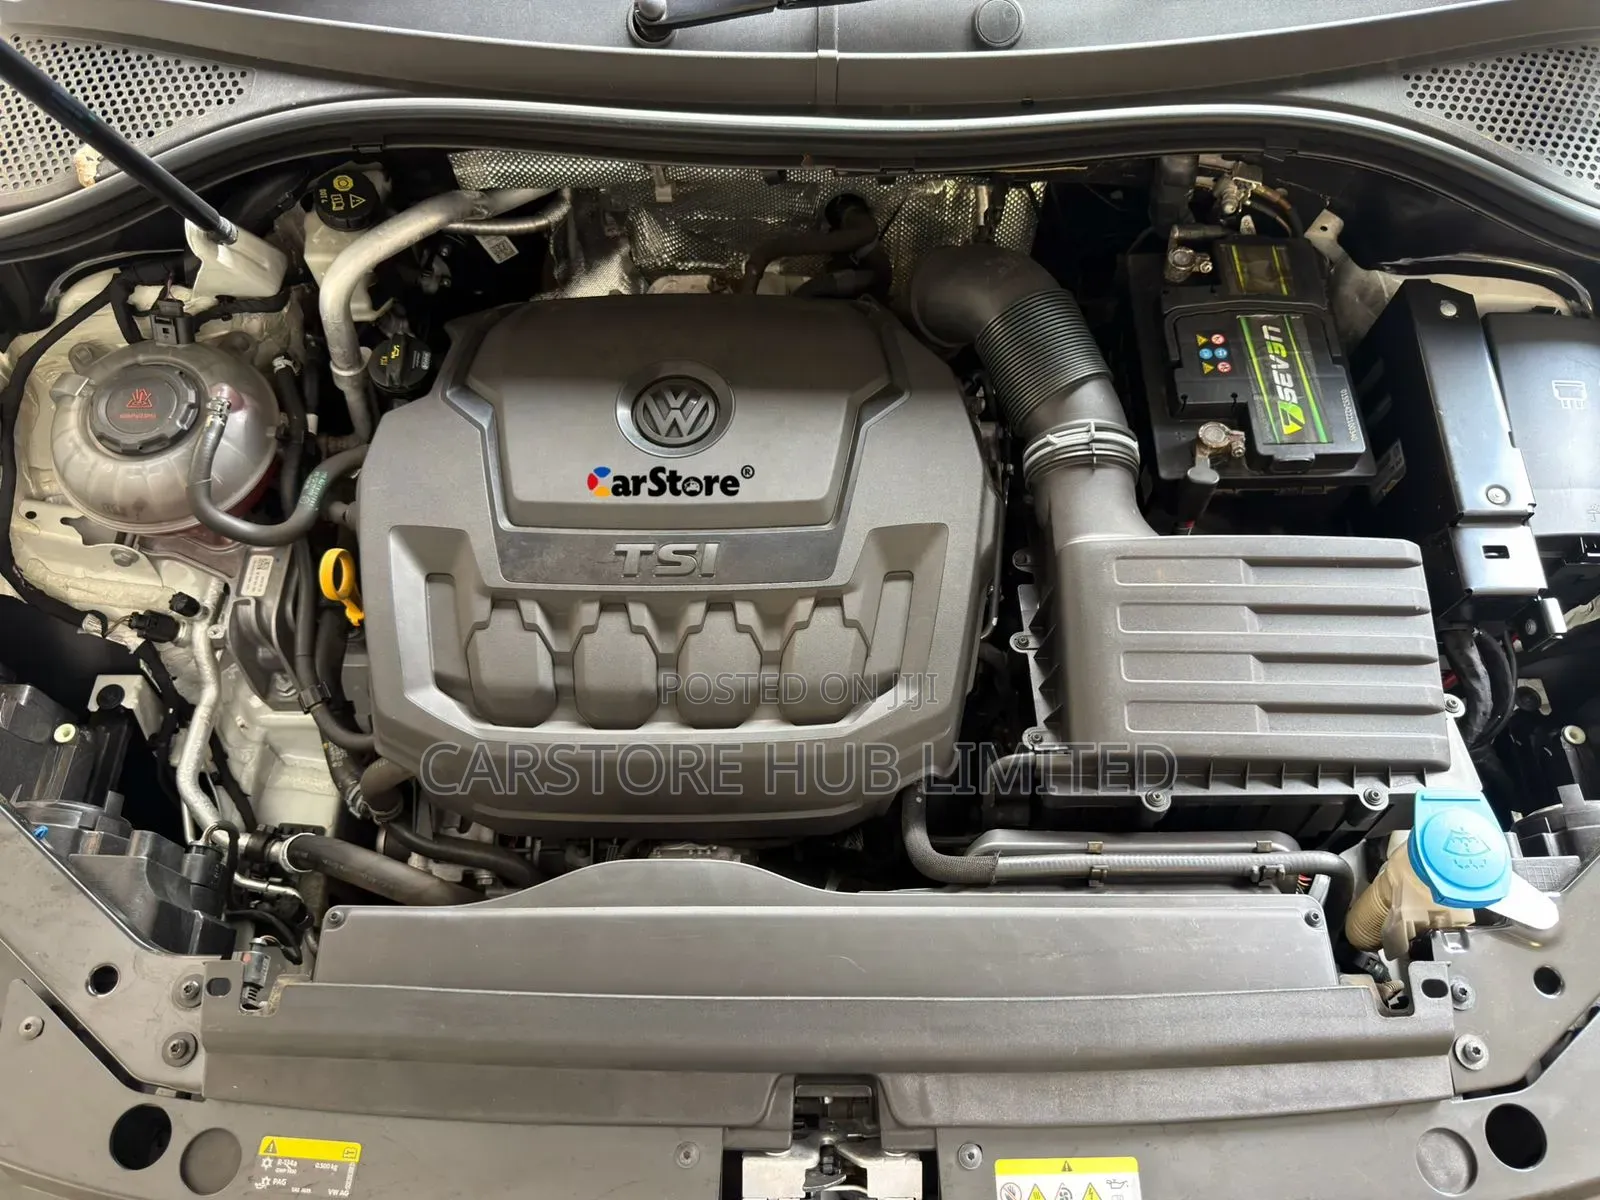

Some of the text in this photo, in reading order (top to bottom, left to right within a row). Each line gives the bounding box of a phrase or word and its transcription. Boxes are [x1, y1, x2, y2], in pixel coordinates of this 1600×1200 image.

[613, 542, 720, 578] TSI
[272, 1178, 287, 1186] PAG
[328, 1188, 350, 1197] VW AG
